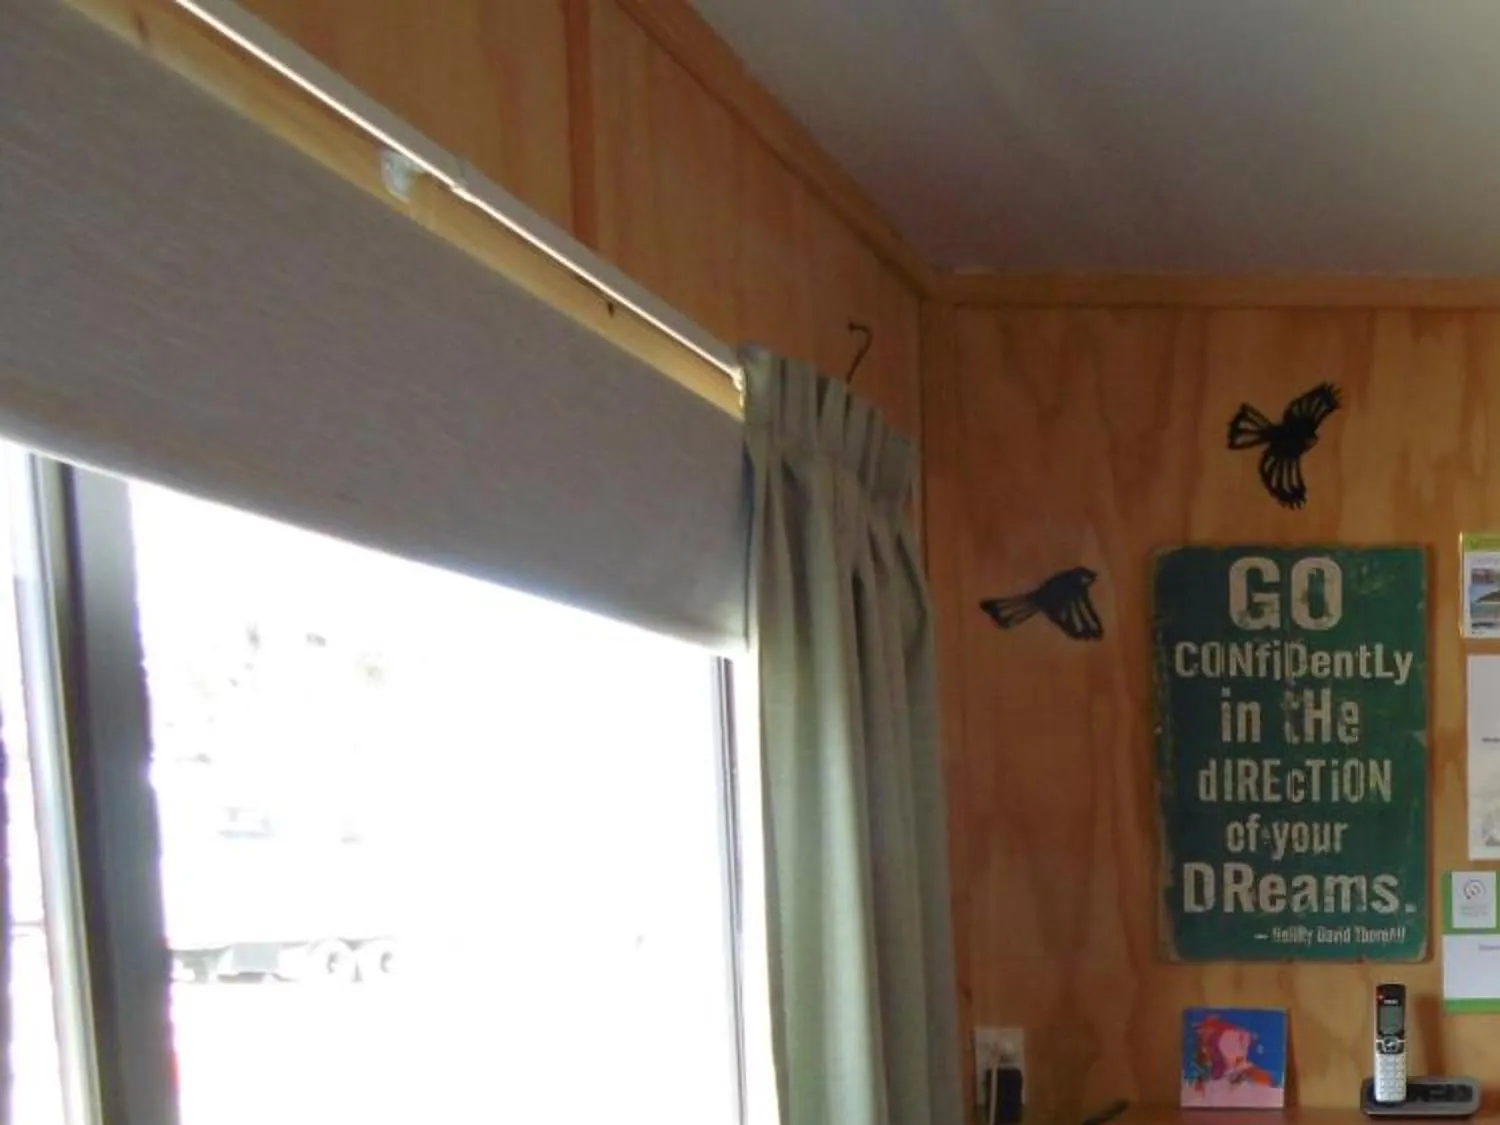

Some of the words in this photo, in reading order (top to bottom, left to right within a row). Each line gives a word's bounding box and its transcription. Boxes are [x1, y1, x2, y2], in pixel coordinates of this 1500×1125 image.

[1228, 556, 1343, 631] GO
[1220, 688, 1262, 743] in
[1226, 814, 1261, 853] of
[1273, 821, 1348, 860] your
